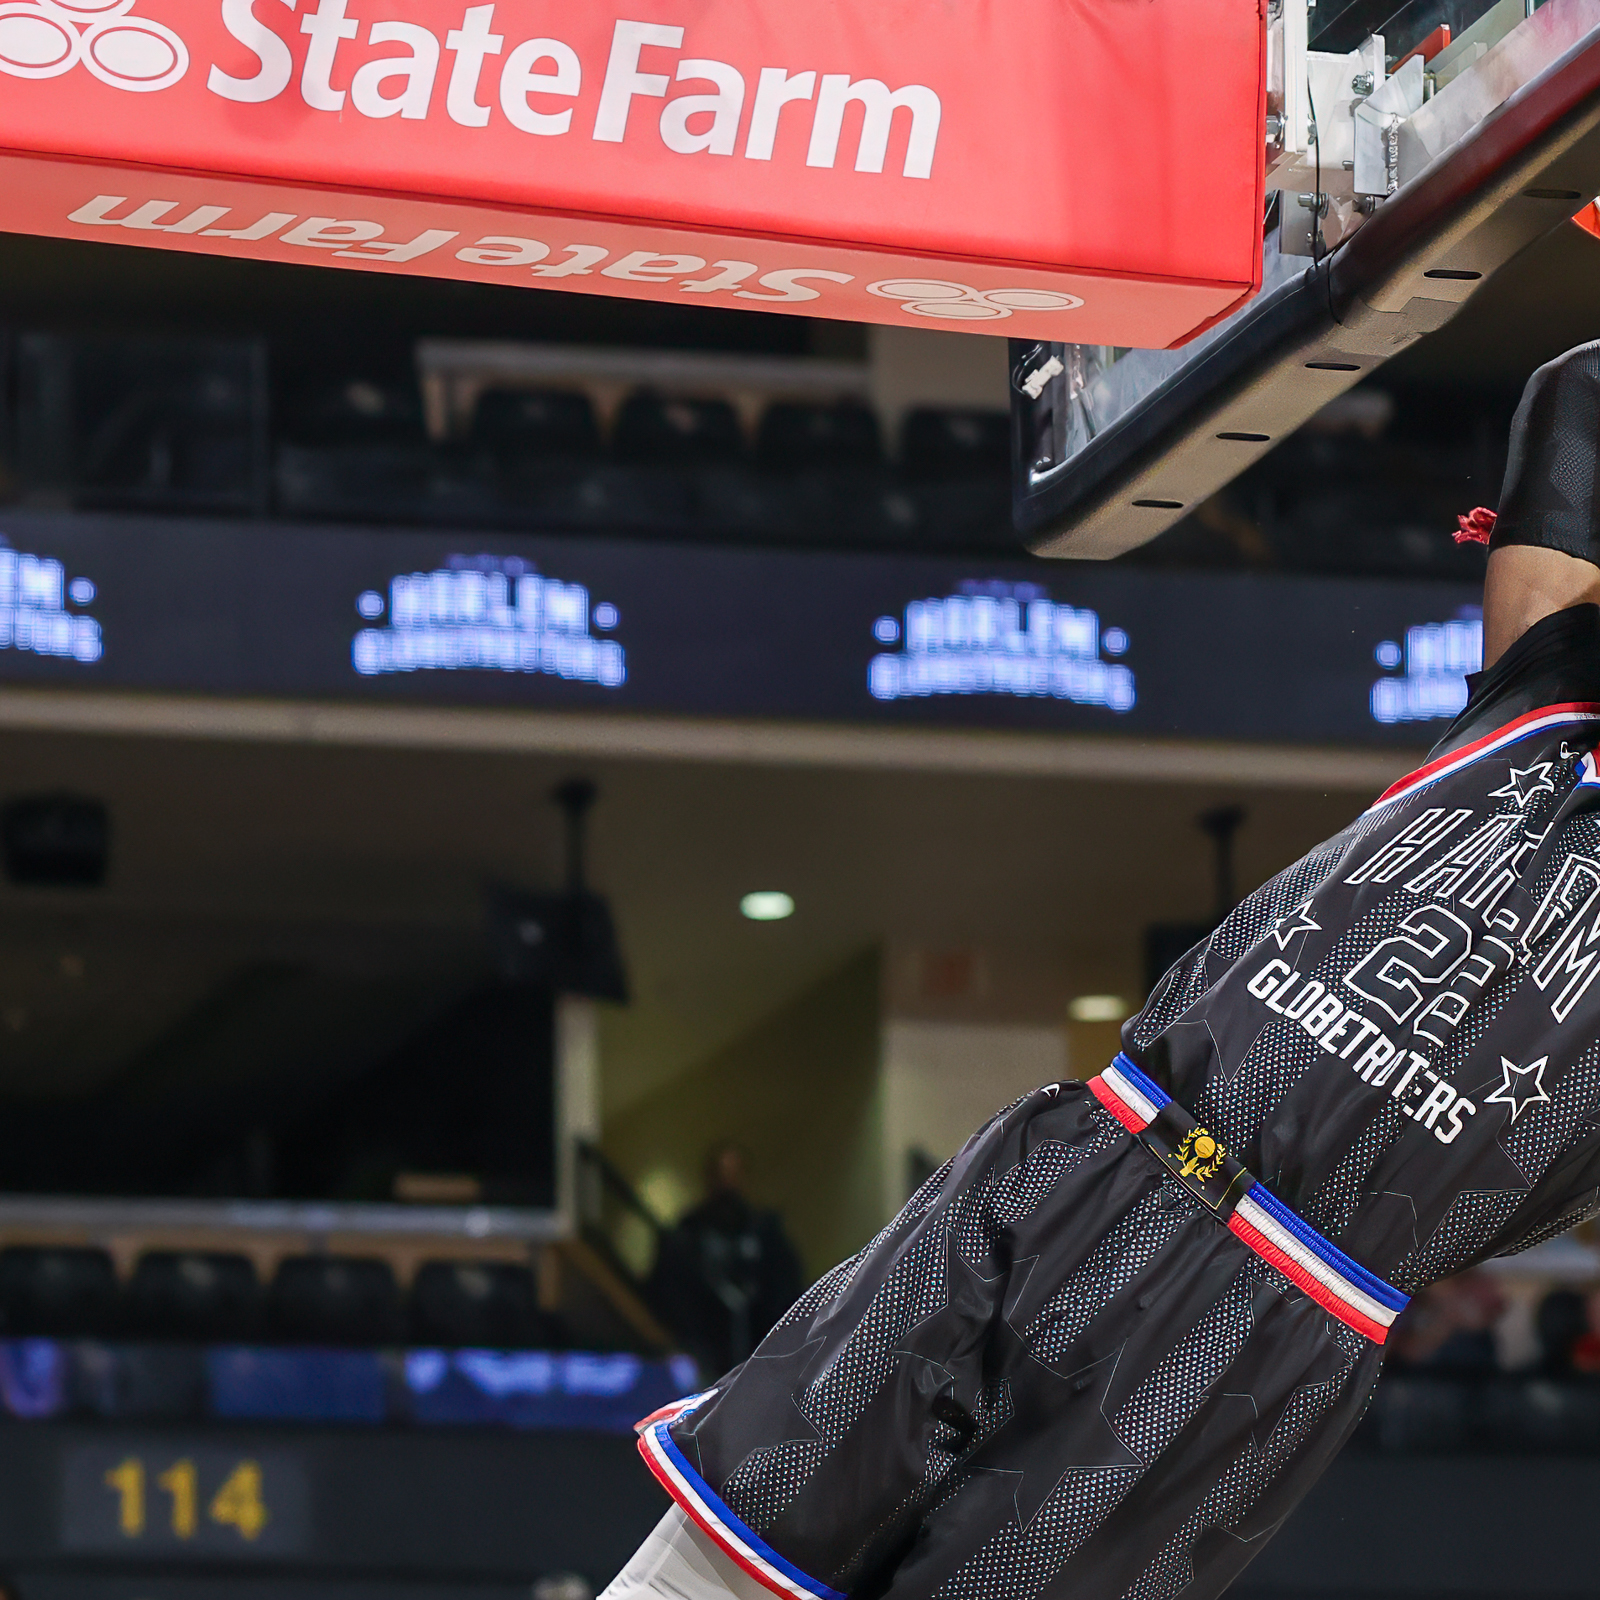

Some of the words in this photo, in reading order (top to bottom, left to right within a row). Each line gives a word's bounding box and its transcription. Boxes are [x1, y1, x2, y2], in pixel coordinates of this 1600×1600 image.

[207, 0, 581, 137] State
[592, 18, 943, 180] Farm
[103, 1457, 270, 1541] 114
